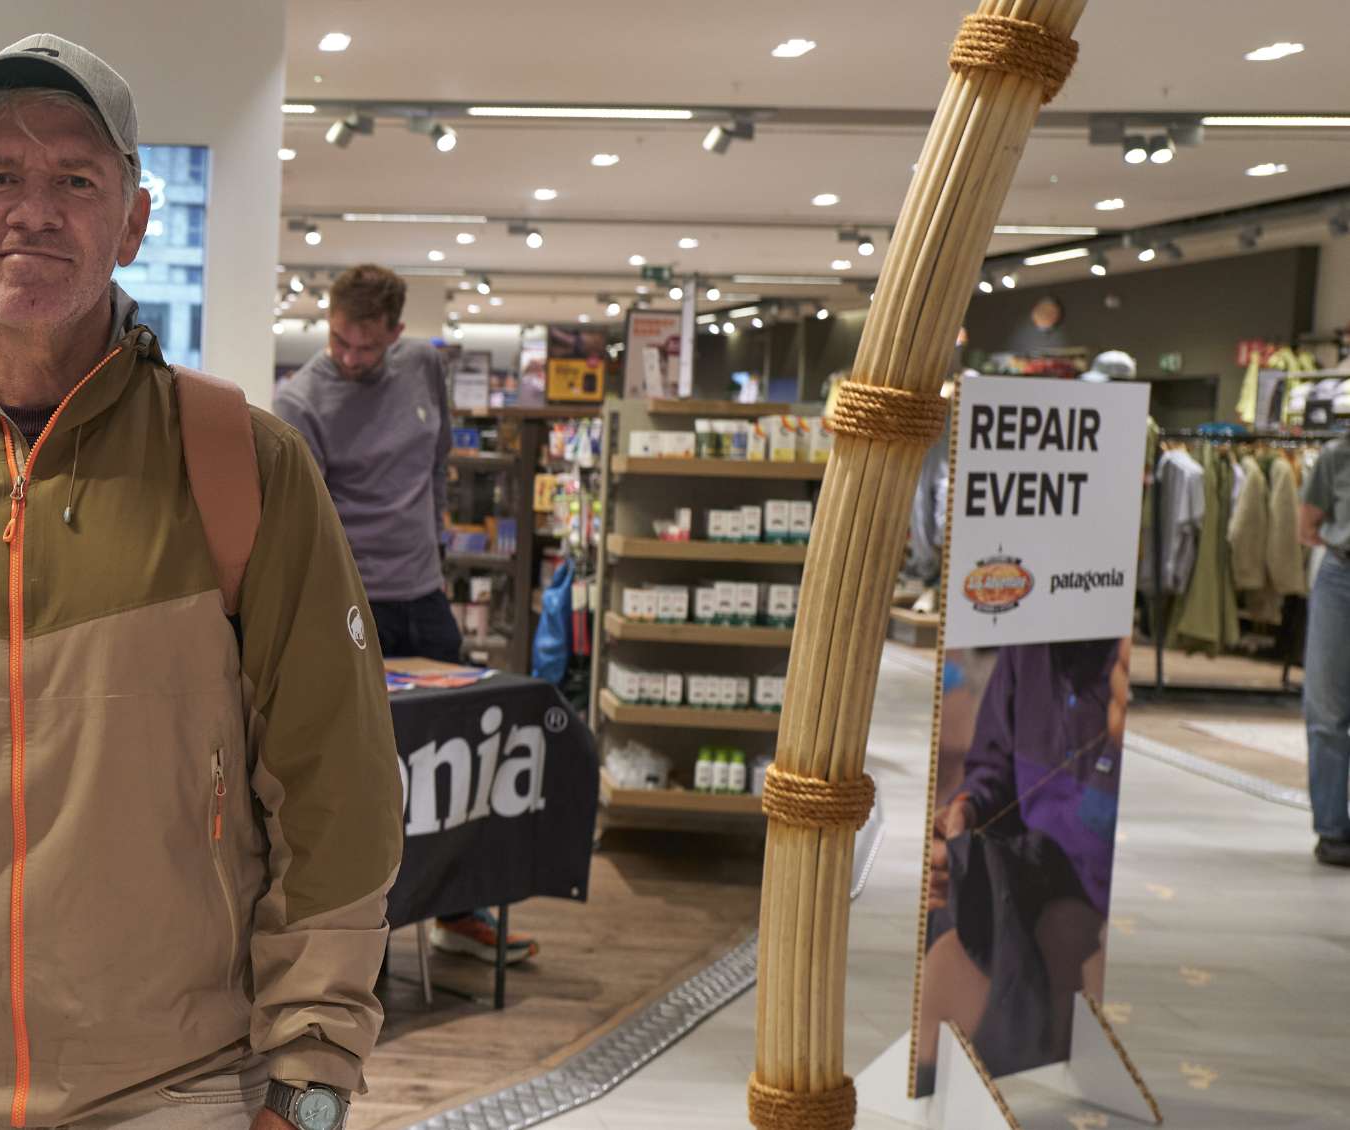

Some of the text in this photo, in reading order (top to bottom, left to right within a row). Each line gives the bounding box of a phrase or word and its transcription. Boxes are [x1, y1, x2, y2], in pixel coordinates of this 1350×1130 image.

[970, 404, 1101, 452] REPAIR
[965, 472, 1088, 517] EVENT
[1050, 568, 1125, 595] patagonia
[398, 705, 547, 837] nia
